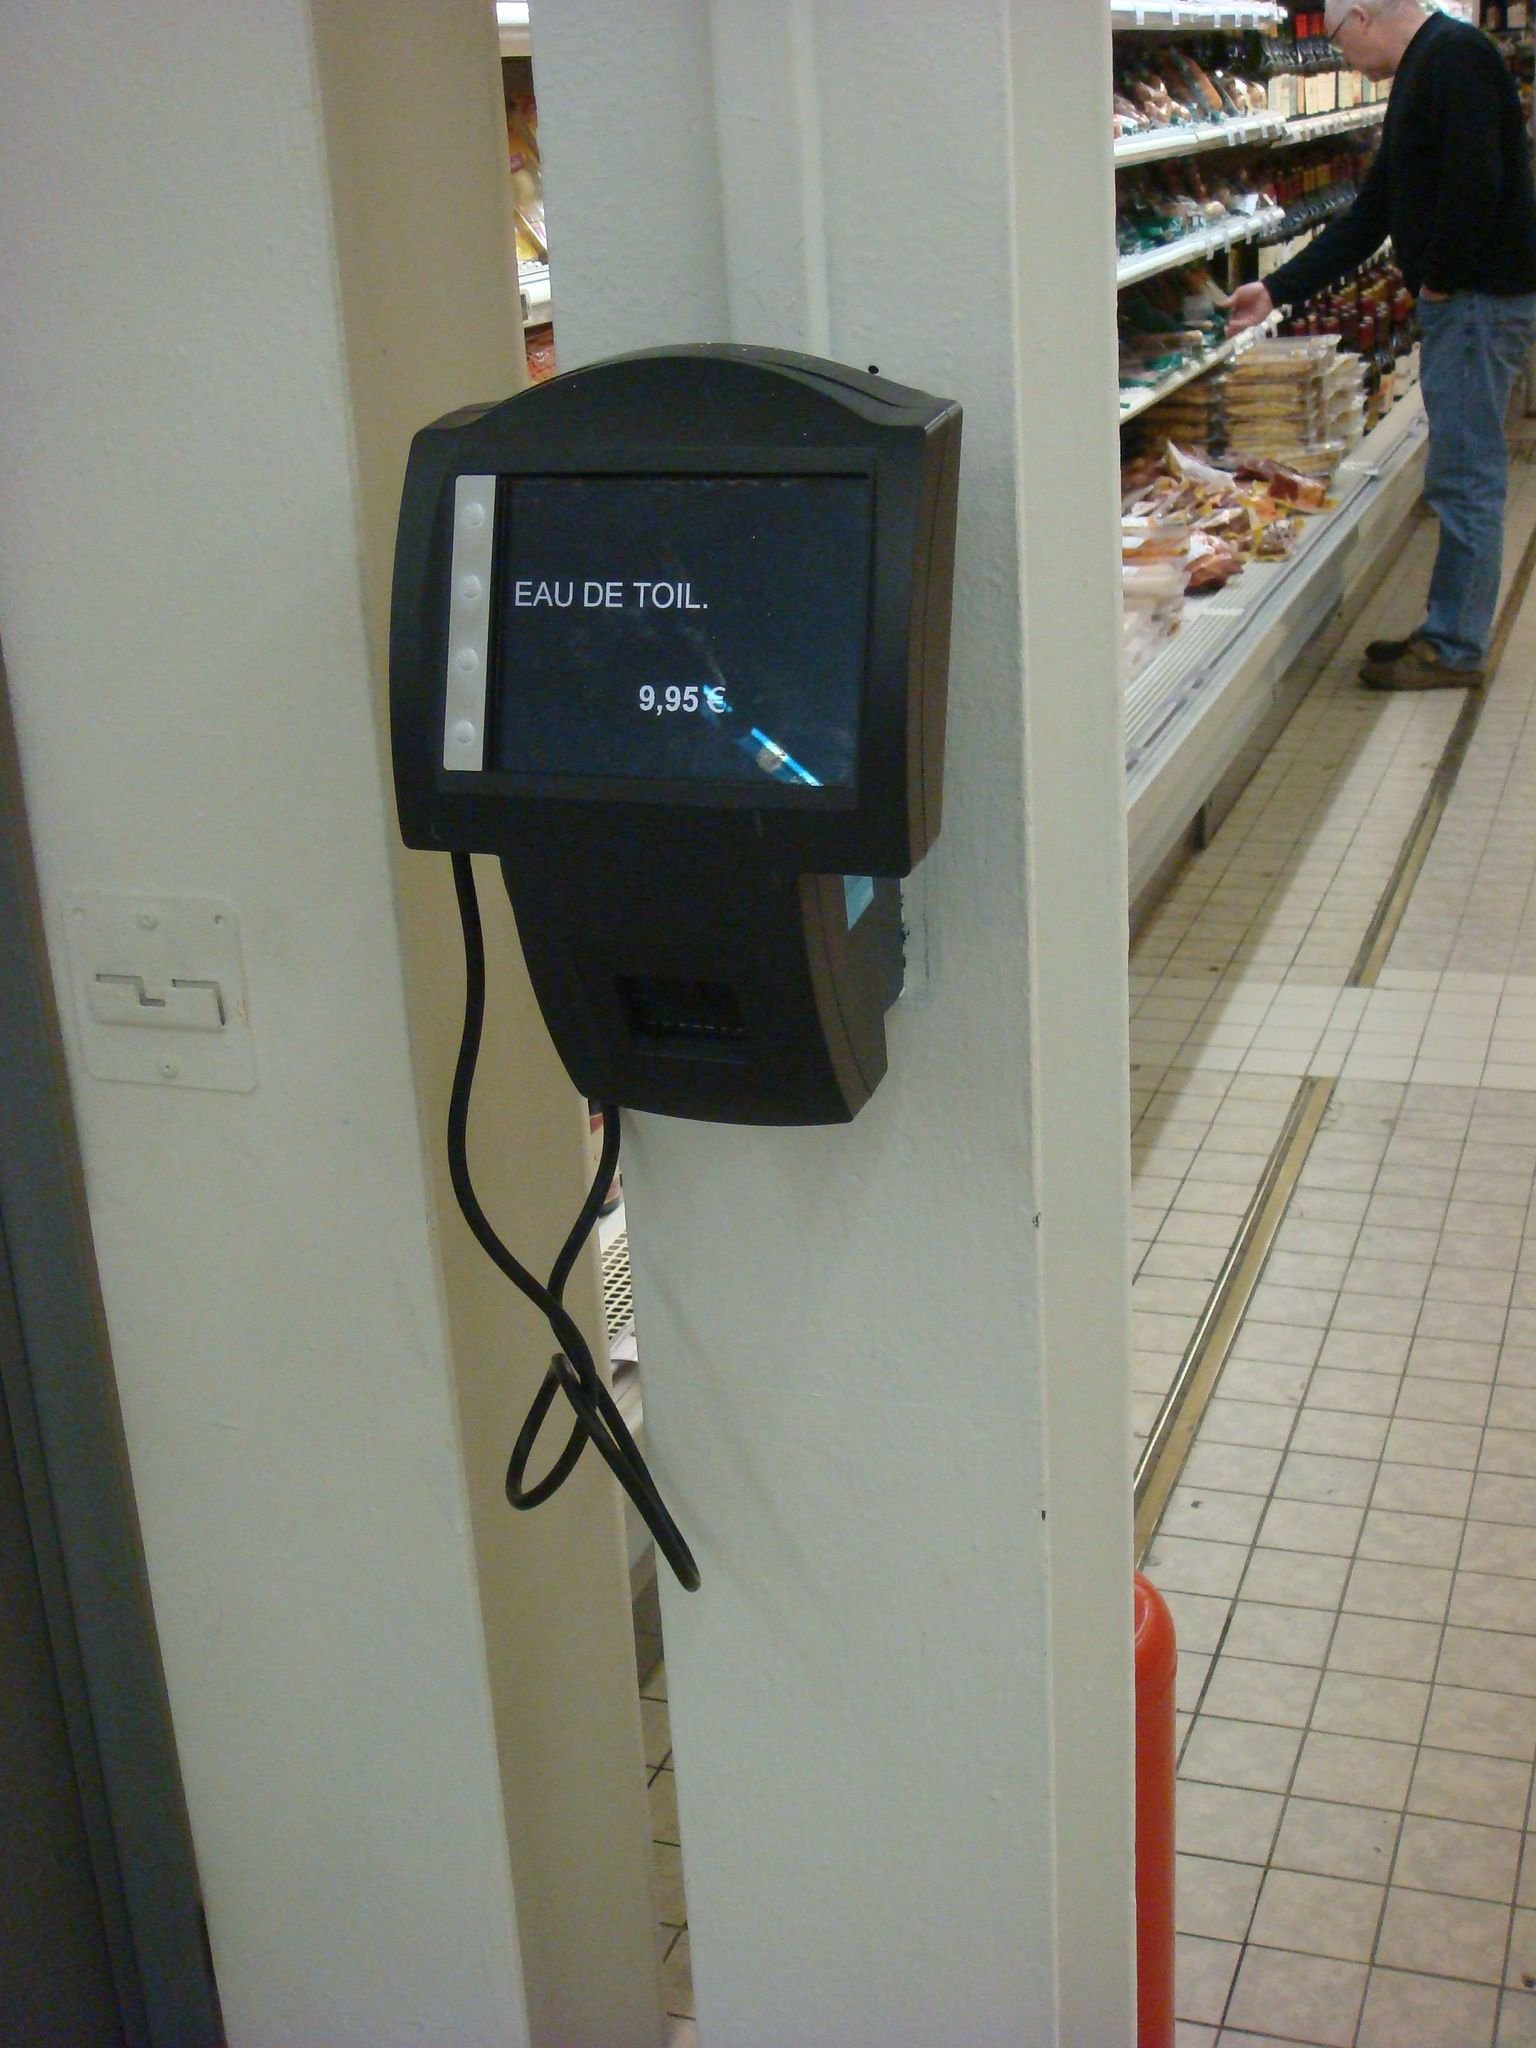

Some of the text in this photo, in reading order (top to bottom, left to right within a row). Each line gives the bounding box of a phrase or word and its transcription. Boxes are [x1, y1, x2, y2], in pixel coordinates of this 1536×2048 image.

[514, 581, 708, 609] EAU DE TOIL.
[638, 684, 727, 716] 9,95 €
